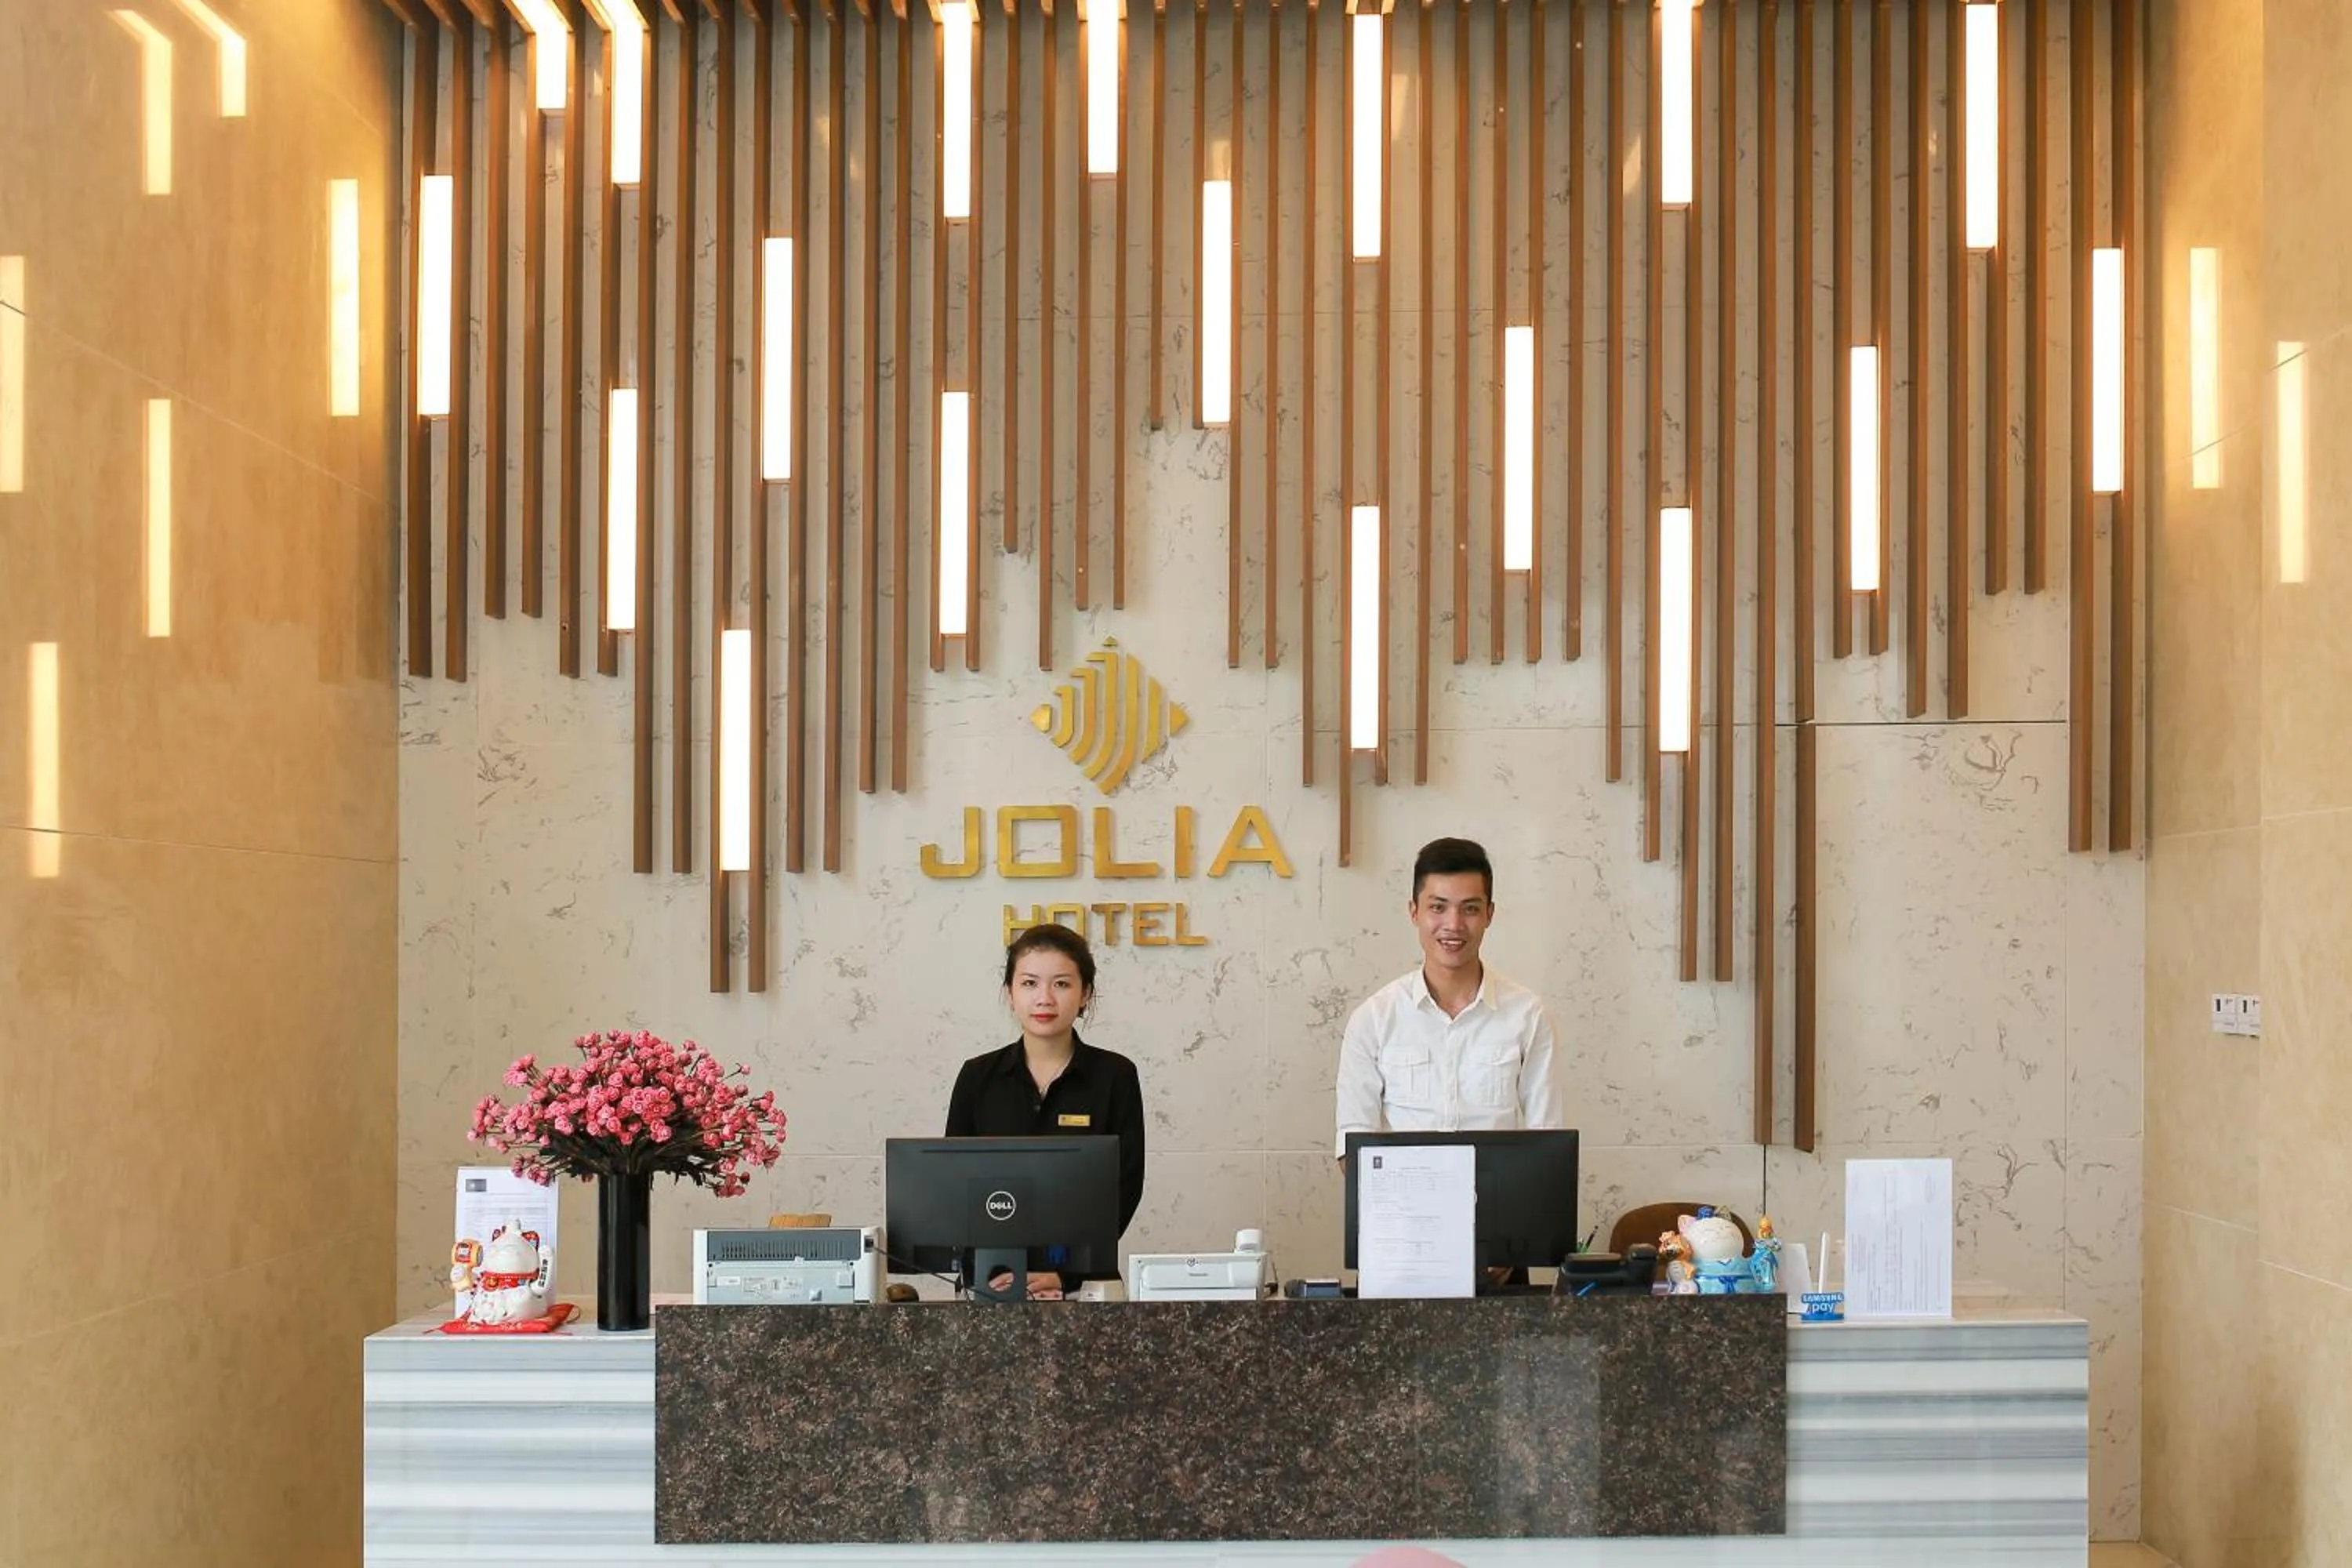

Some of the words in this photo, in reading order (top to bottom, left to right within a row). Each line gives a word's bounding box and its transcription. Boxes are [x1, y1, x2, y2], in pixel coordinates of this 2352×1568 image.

[920, 804, 1294, 879] JOLIA
[1002, 902, 1207, 946] HOTEL
[989, 1201, 1013, 1210] DELL
[1802, 1294, 1843, 1302] SAMSUNG
[1812, 1303, 1835, 1315] pay
